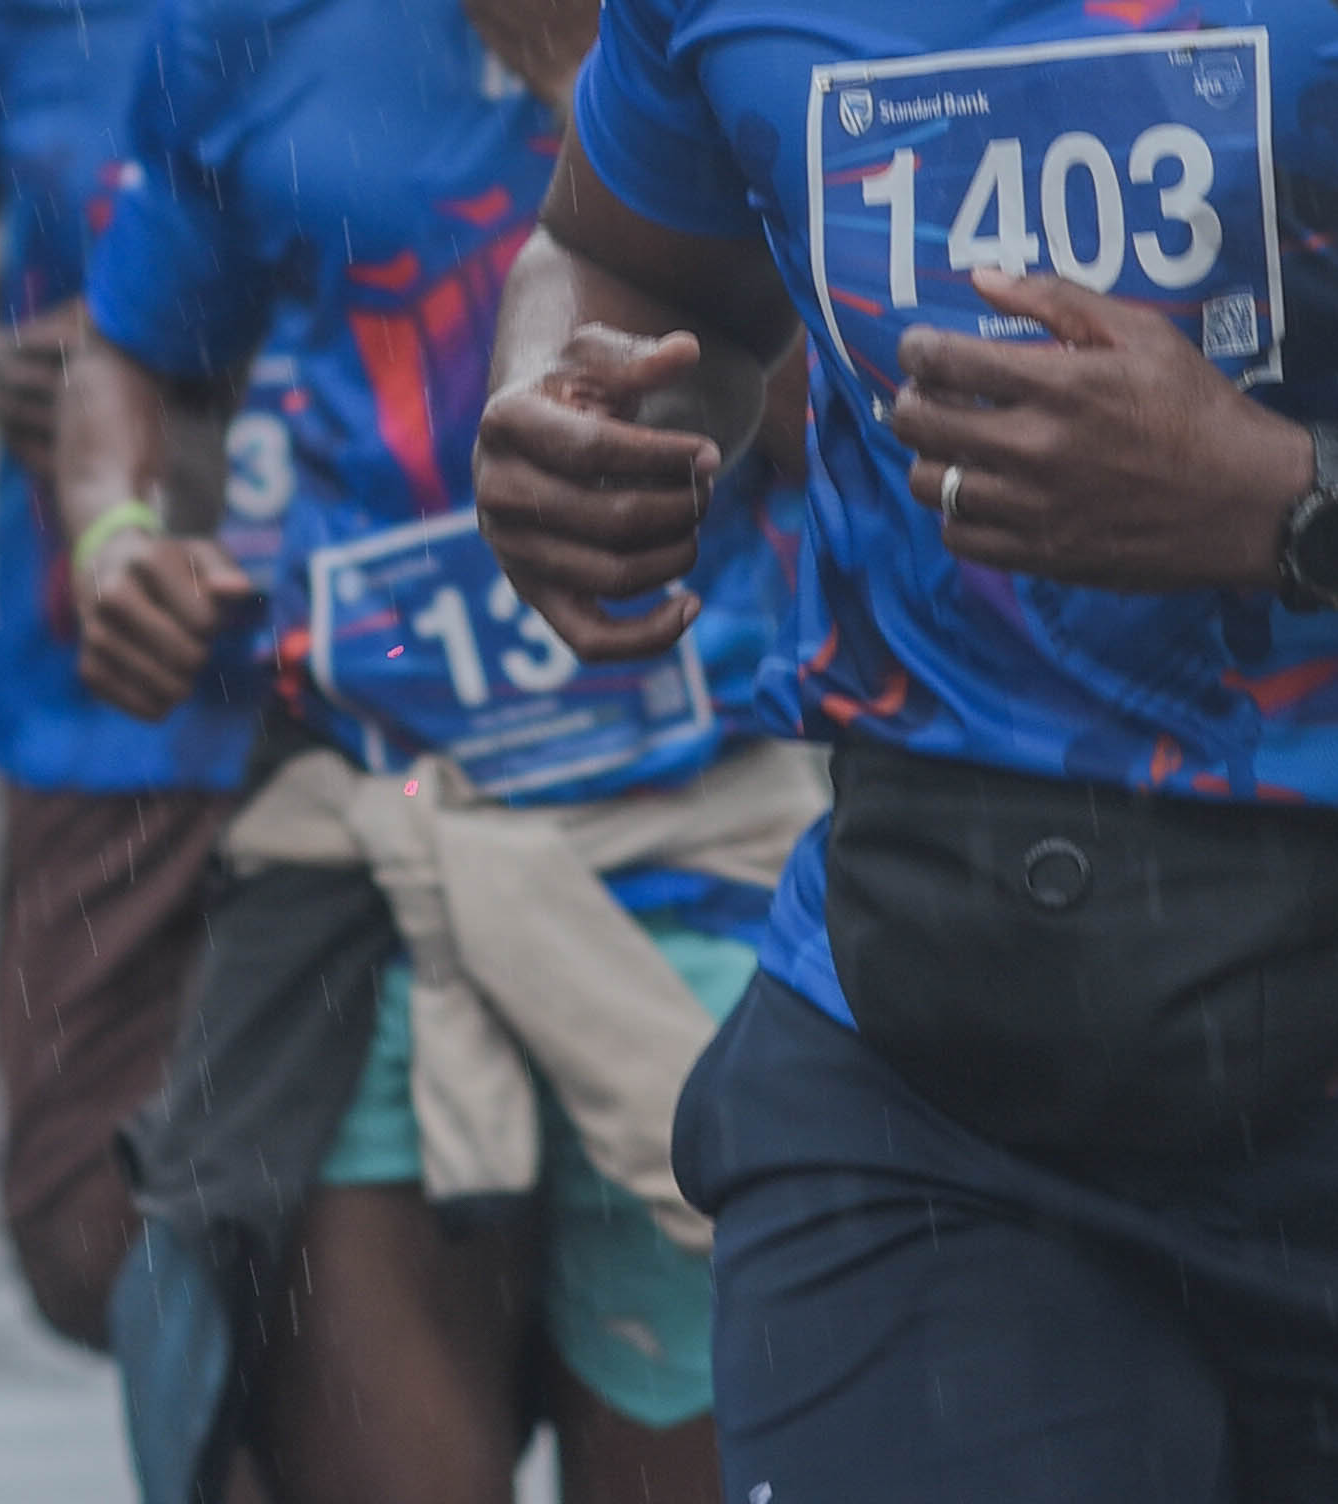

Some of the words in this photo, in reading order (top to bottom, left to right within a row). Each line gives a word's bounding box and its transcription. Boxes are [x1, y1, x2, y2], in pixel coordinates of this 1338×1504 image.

[879, 93, 942, 125] Standard
[944, 89, 990, 116] Bank
[862, 123, 1223, 309] 1403
[413, 574, 579, 707] 13
